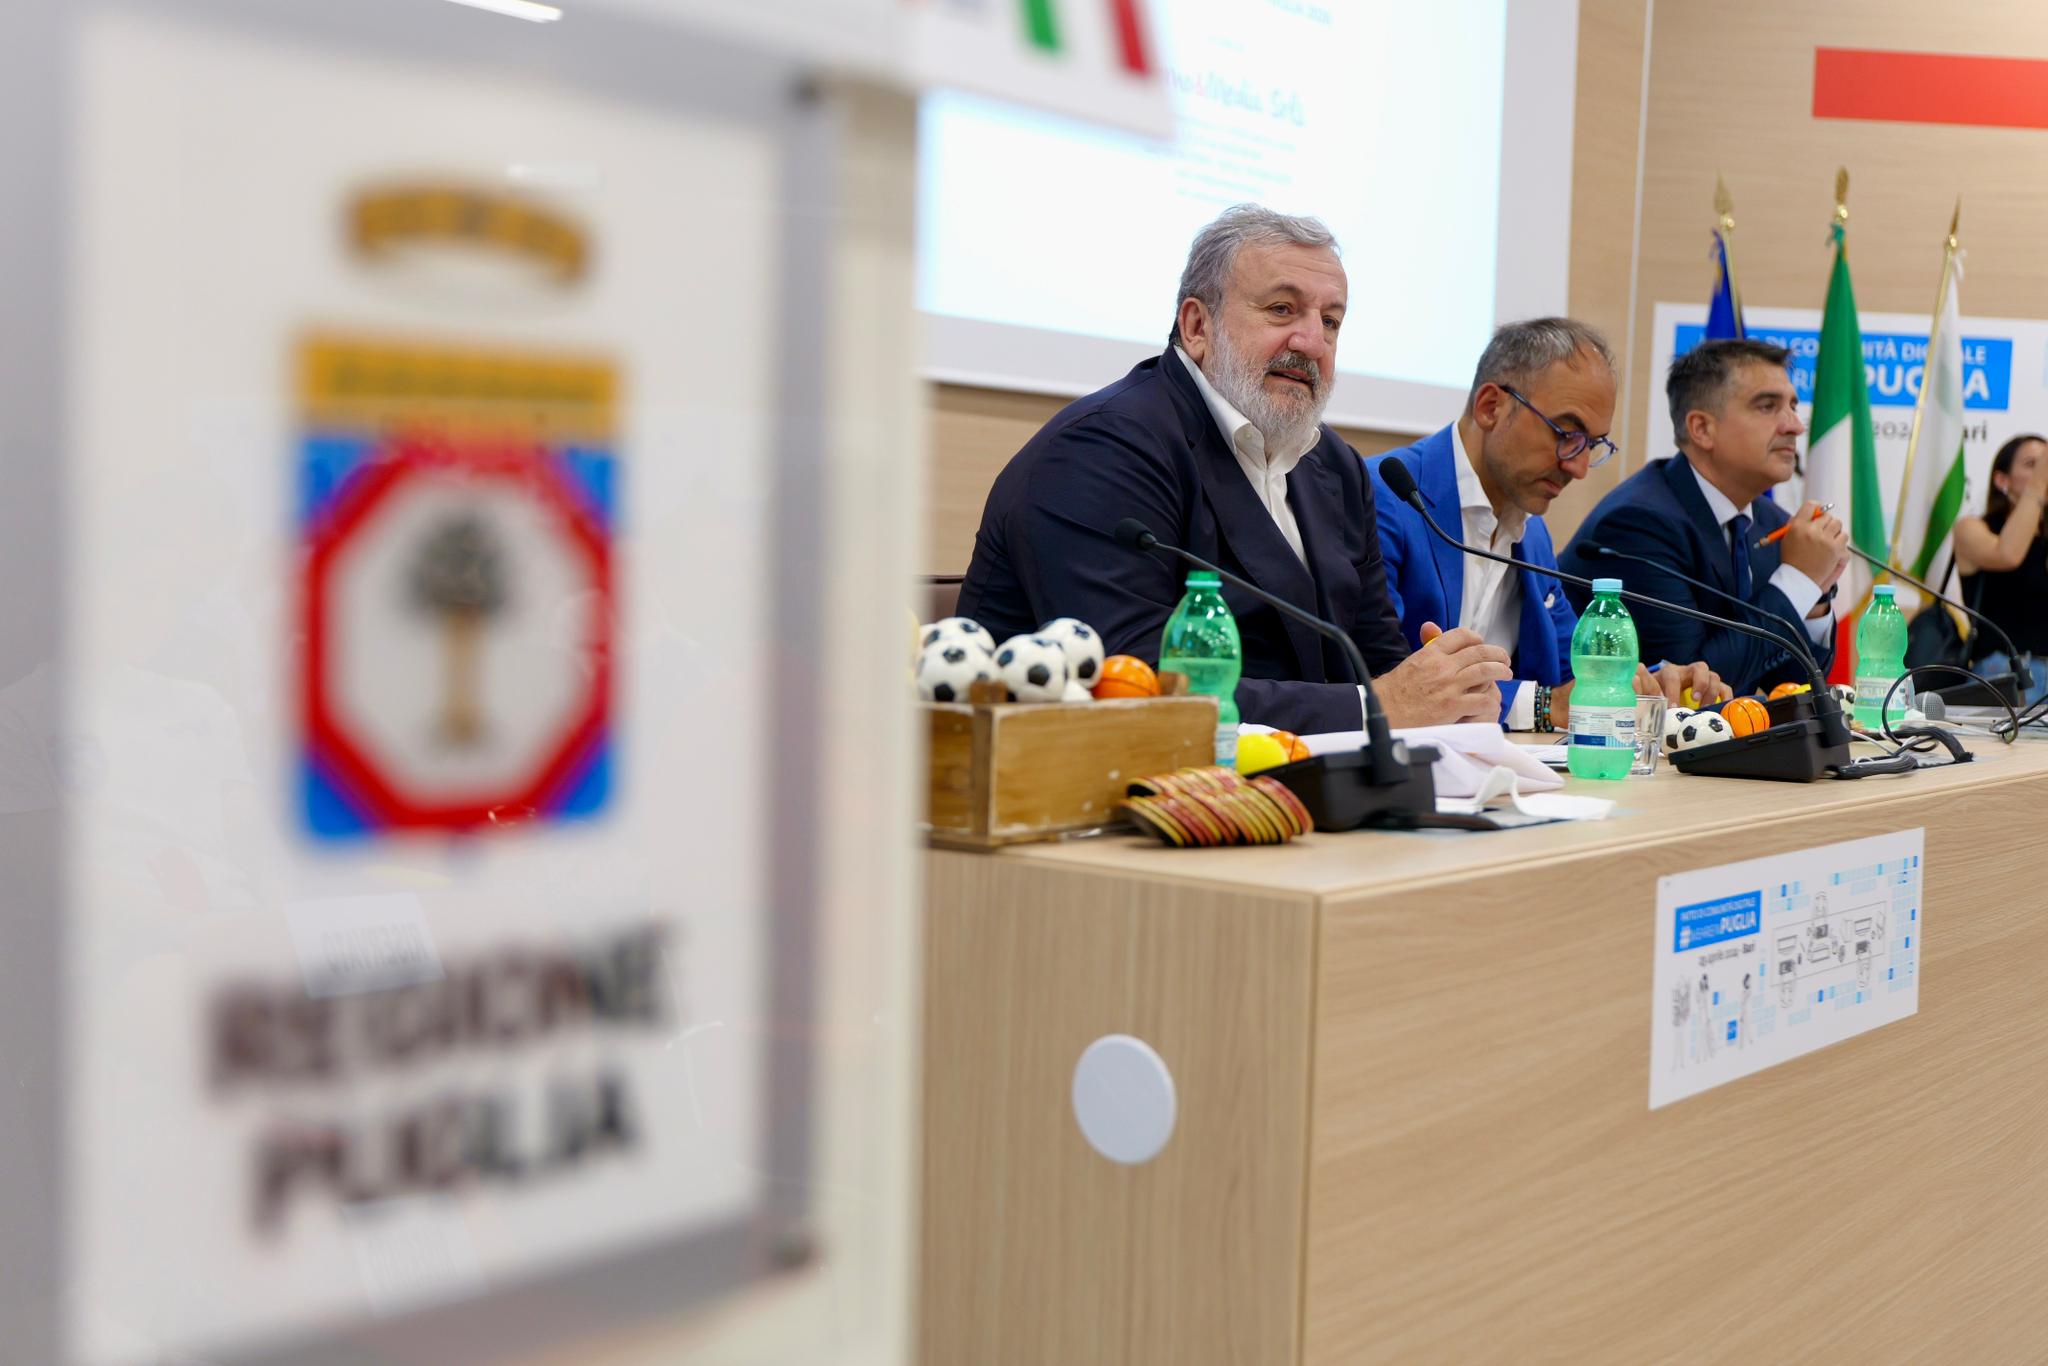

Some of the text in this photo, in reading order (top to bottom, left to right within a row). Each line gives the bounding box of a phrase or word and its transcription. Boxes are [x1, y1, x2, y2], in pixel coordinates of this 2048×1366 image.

[1864, 364, 1991, 401] PUGA
[1720, 911, 1756, 934] PUGLIA
[208, 918, 678, 1102] REGIONE
[250, 1062, 642, 1238] PUGLIA
